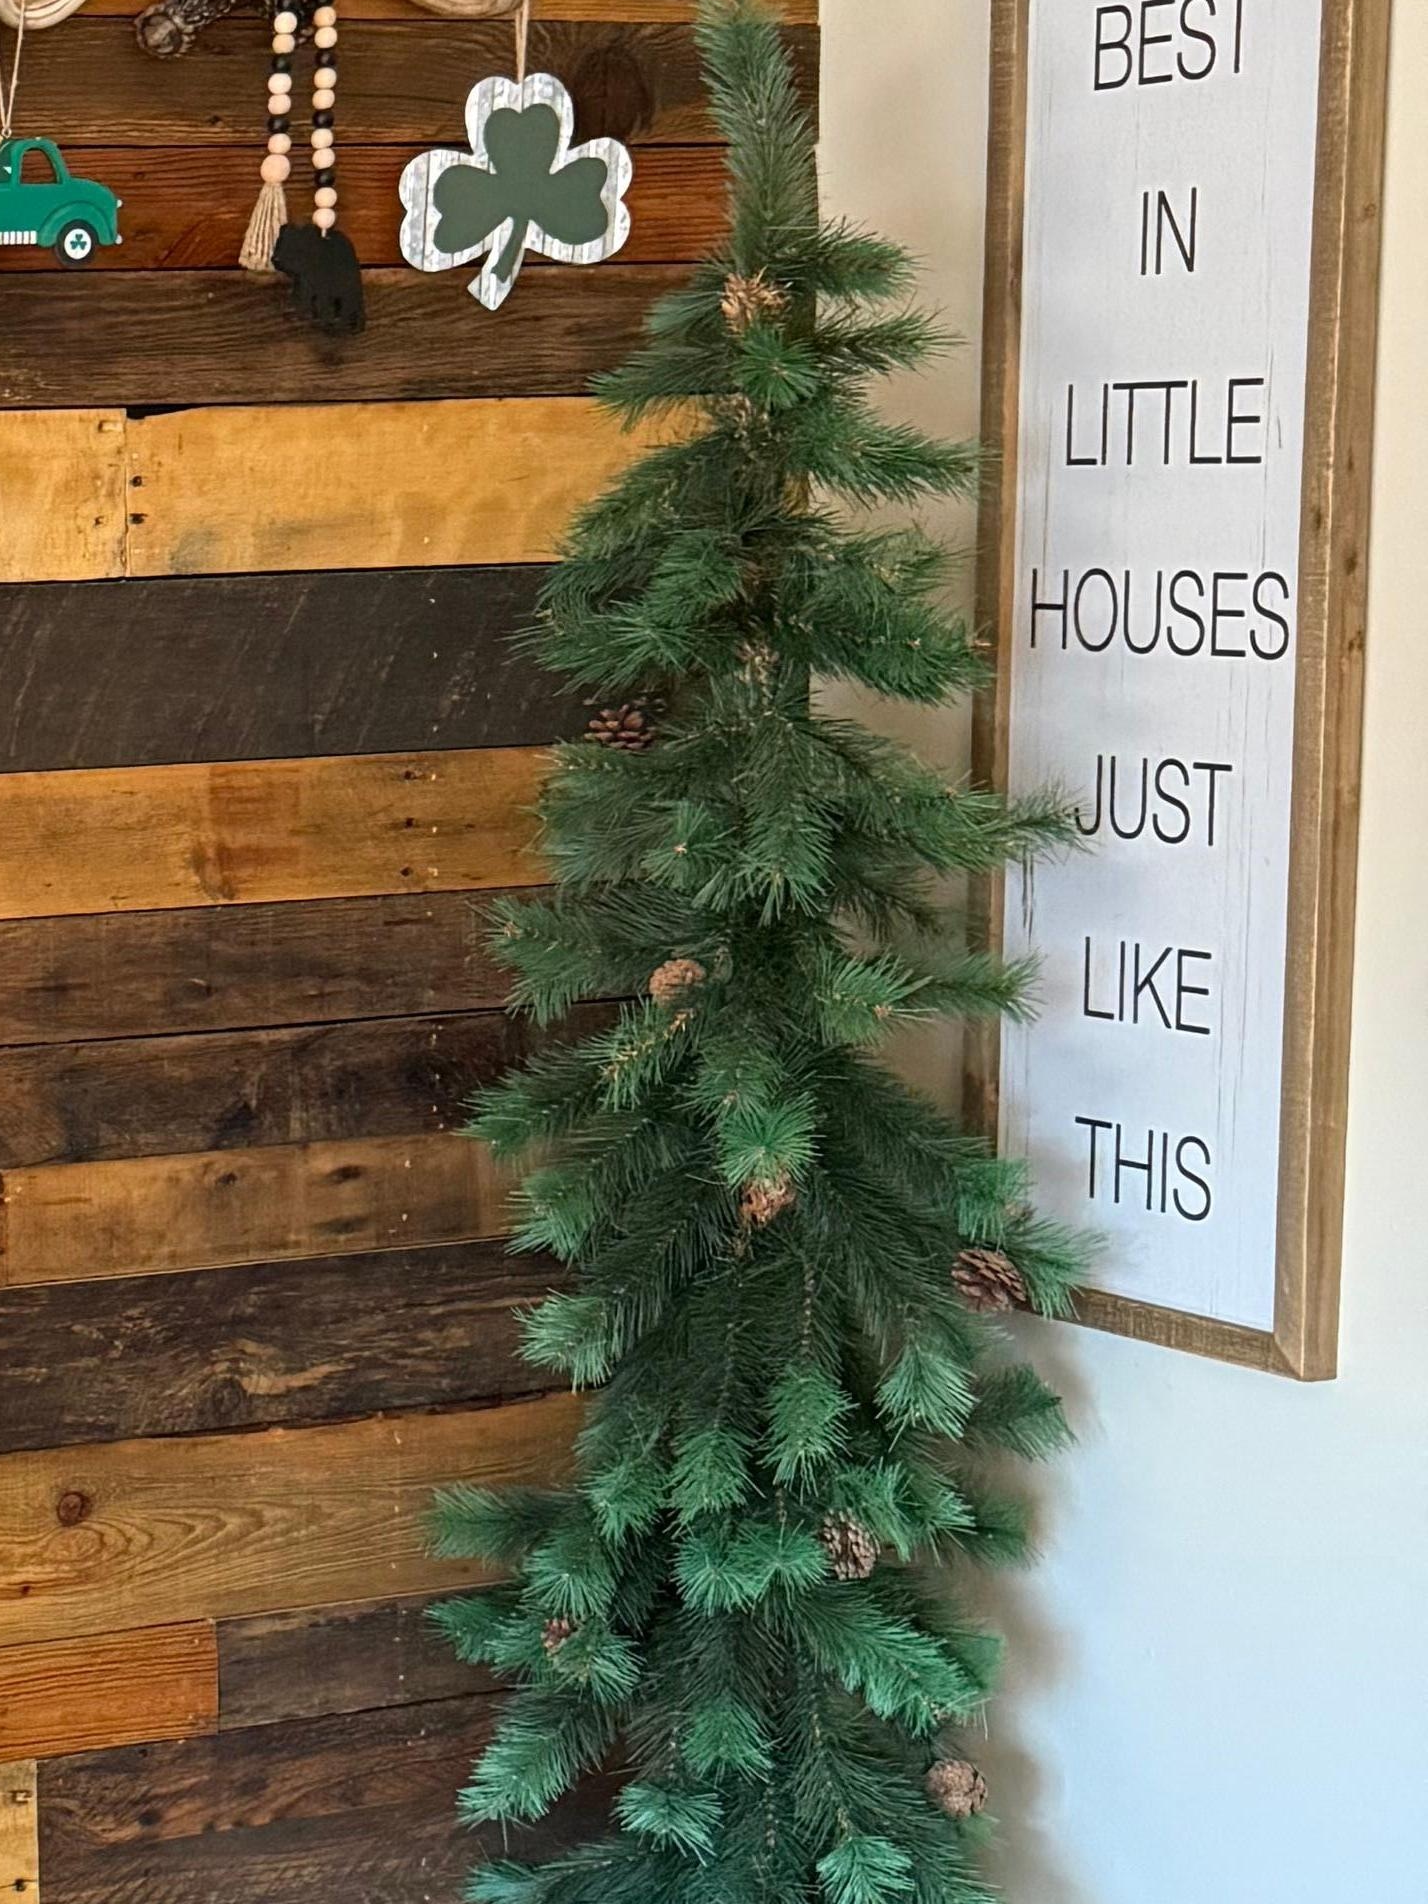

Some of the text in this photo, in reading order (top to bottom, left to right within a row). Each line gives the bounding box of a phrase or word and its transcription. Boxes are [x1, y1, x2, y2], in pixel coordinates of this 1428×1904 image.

[1139, 186, 1198, 277] IN
[1065, 376, 1265, 467] LITTLE
[1029, 566, 1290, 662] HOUSES
[1074, 753, 1234, 847] JUST
[1082, 935, 1213, 1036] LIKE
[1073, 1115, 1212, 1222] THIS
